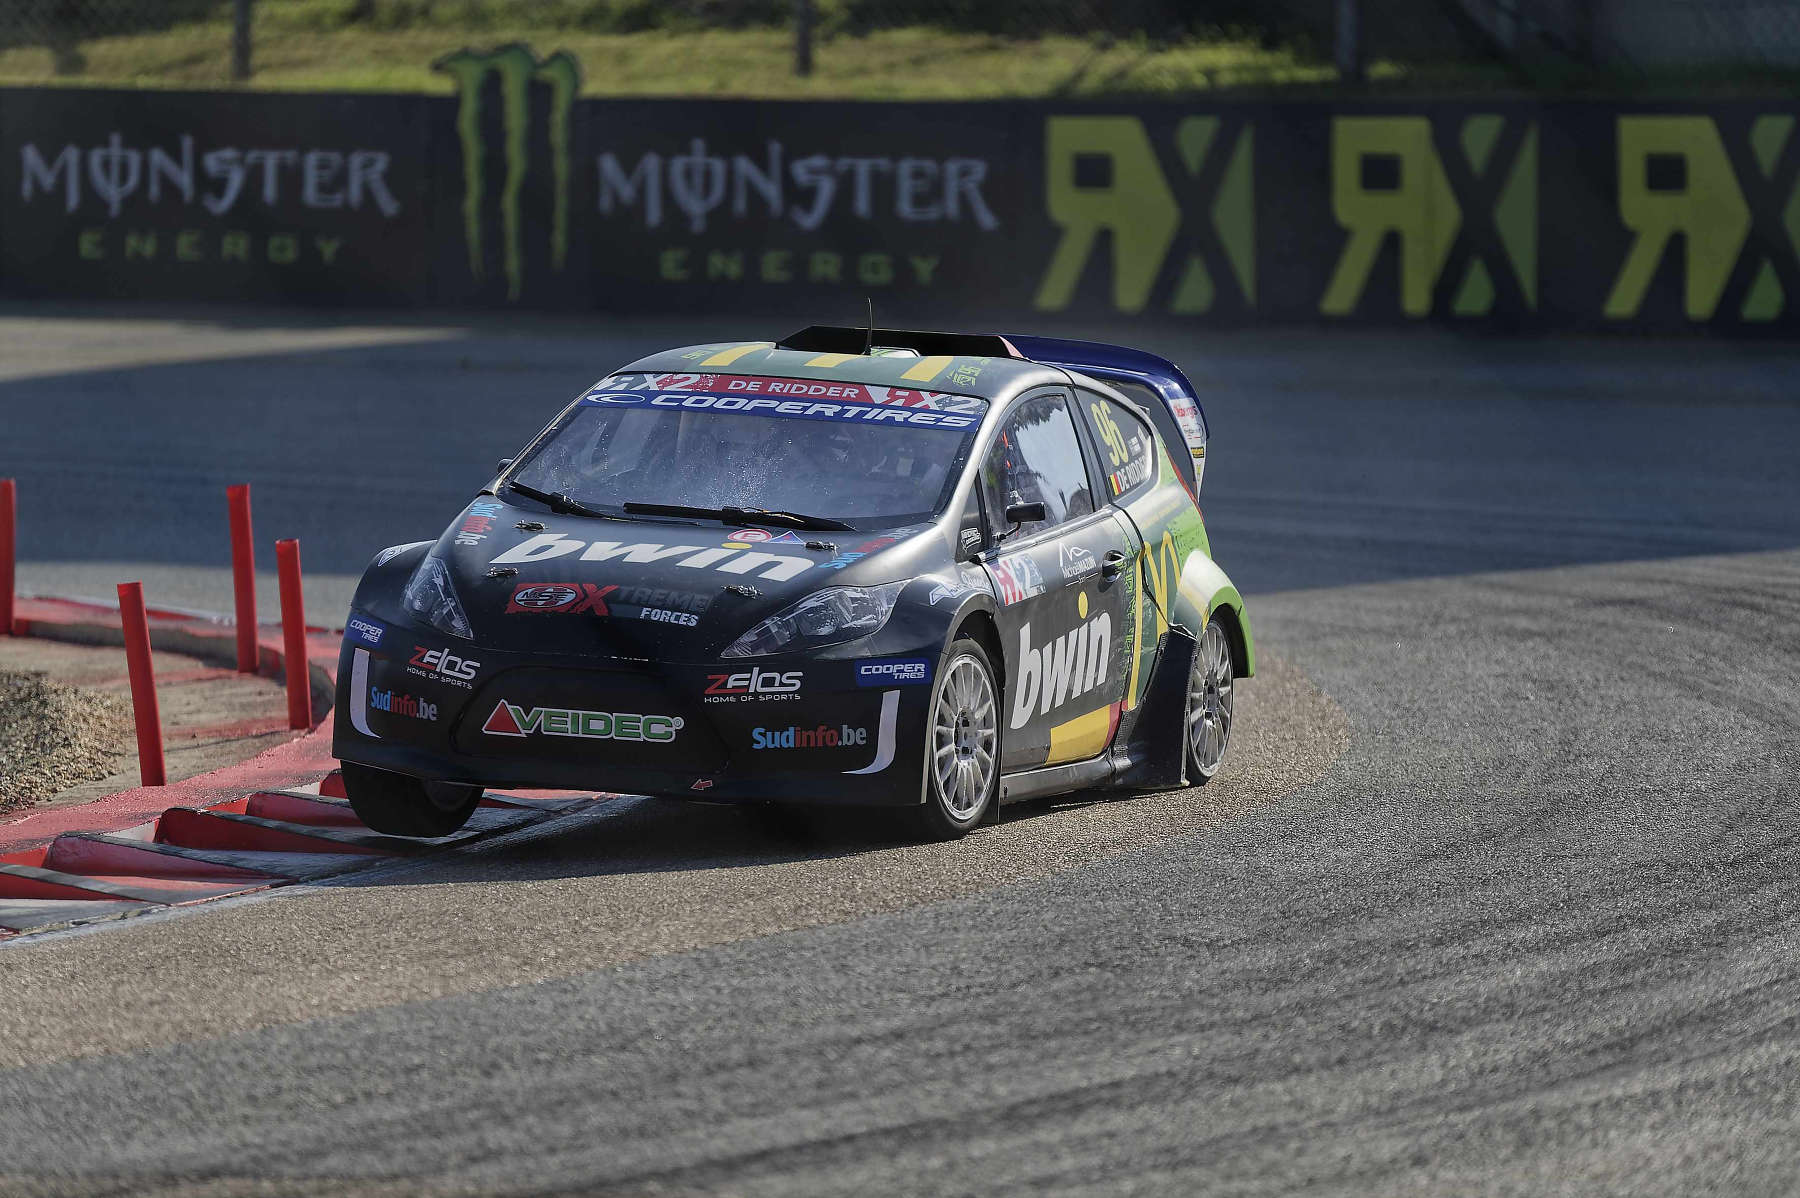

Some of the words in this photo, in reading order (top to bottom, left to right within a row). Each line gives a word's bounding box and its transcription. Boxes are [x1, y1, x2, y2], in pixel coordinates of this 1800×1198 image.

[20, 133, 399, 217] MONSTER
[598, 138, 998, 232] MONSTER
[79, 231, 342, 263] ENERGY
[659, 249, 940, 285] ENERGY
[728, 380, 762, 391] DE
[768, 382, 859, 398] RIDDER
[1116, 468, 1130, 492] DE
[489, 533, 814, 582] bwin
[350, 619, 383, 638] COOPER
[640, 607, 699, 627] FORCES
[361, 632, 380, 643] TIRES
[860, 663, 925, 675] COOPER
[1010, 591, 1112, 730] bwin
[406, 666, 427, 678] HOME
[428, 672, 439, 681] OF
[440, 677, 473, 690] SPORTS
[892, 672, 925, 680] TIRES
[370, 686, 438, 721] Sudinfo.be
[758, 693, 801, 702] SPORTS
[751, 724, 867, 750] Sudinfo.be
